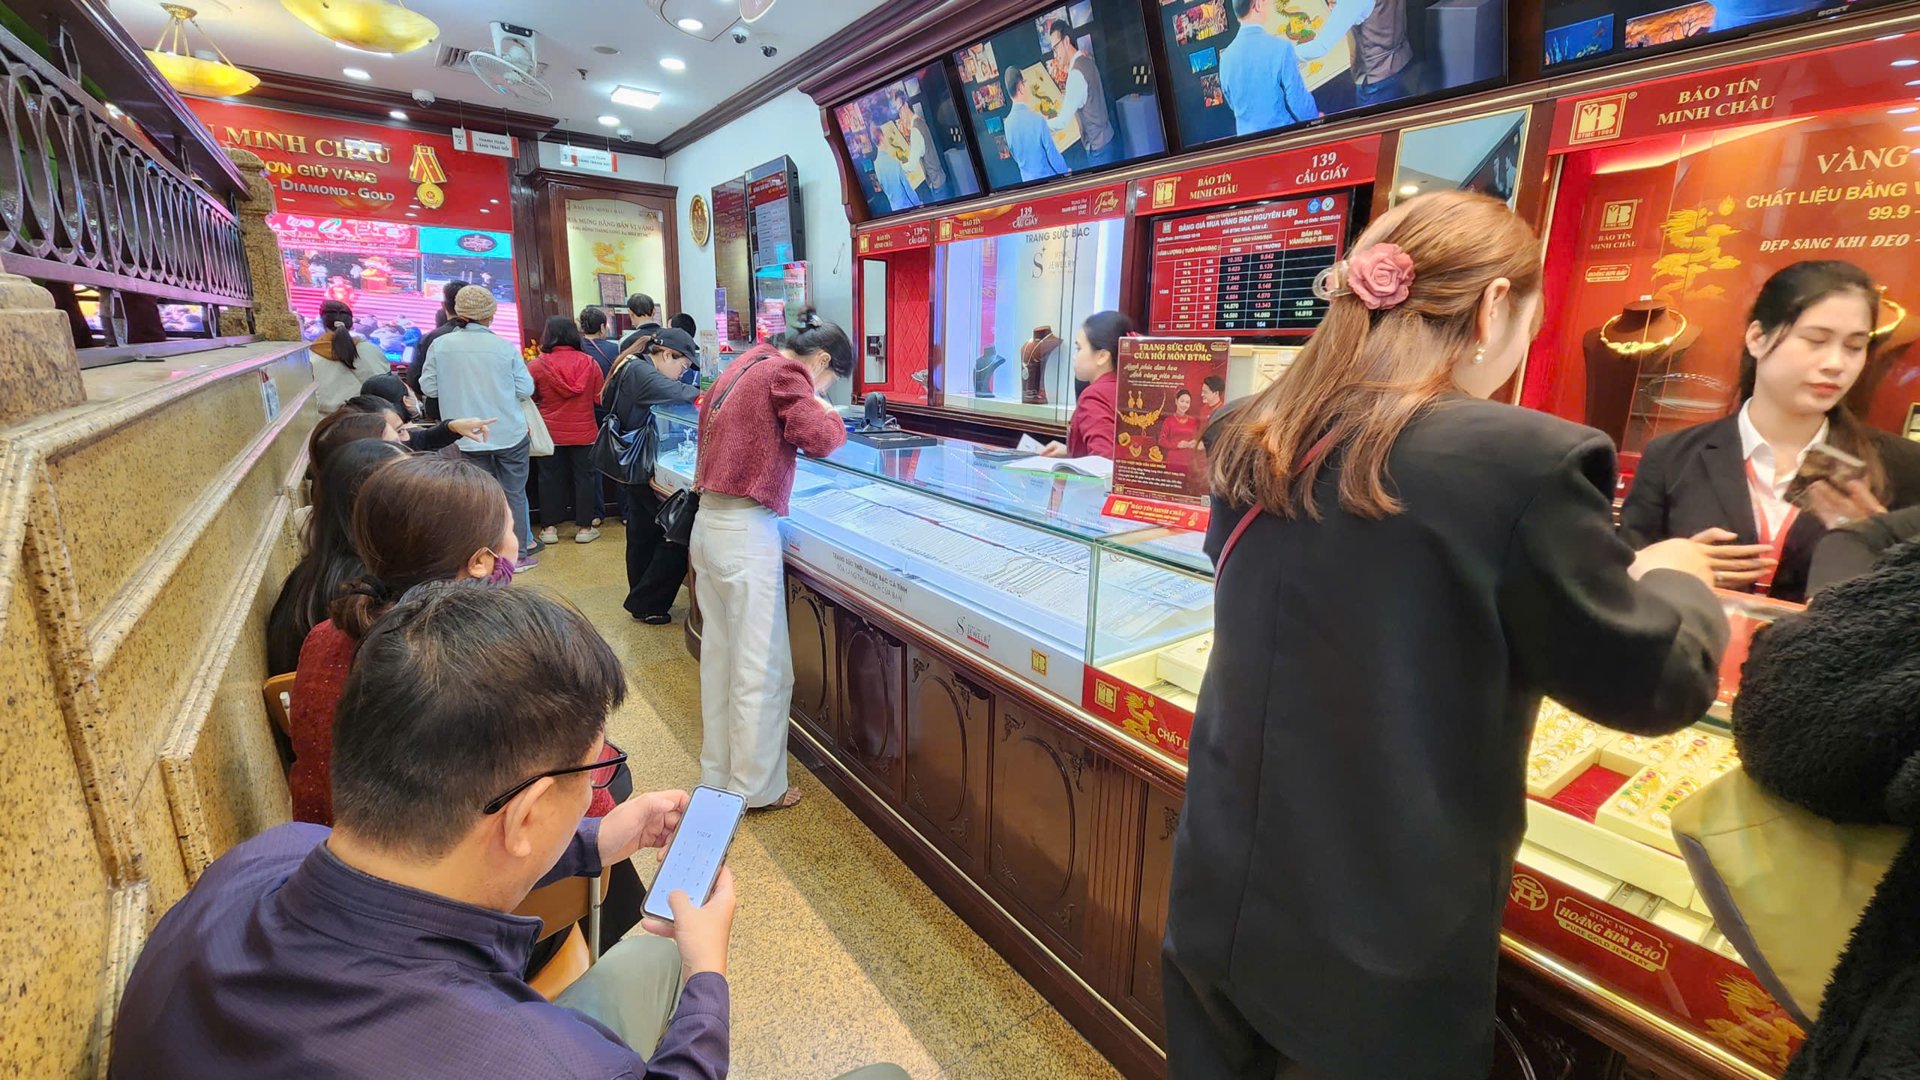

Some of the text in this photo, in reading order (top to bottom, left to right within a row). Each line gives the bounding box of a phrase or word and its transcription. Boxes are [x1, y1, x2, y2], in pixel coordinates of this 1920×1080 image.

[1817, 5, 1850, 18] SONY
[1677, 77, 1761, 105] BẢO TÍN
[1656, 95, 1777, 126] MINH CHÂU
[225, 126, 309, 155] MINH
[315, 137, 392, 164] CHÂU
[1311, 152, 1338, 168] 139
[1816, 145, 1911, 175] VÀNG
[265, 160, 378, 184] ƠN GIỮ VÀNG
[1197, 171, 1233, 188] BẢO TÍN
[1295, 163, 1350, 186] CẦU GIẤY
[357, 187, 395, 202] GOLD
[1189, 181, 1239, 200] MINH CHÂU
[1745, 187, 1796, 209] CHẤT
[1798, 186, 1841, 205] LIỆU
[1844, 180, 1907, 201] BẰNG
[1020, 206, 1033, 217] 139
[1206, 220, 1221, 229] MUA
[1221, 217, 1238, 227] VÀNG
[1238, 214, 1253, 226] BẠC
[1253, 210, 1281, 222] NGUYÊN
[1282, 208, 1298, 219] LIỆU
[1867, 204, 1911, 221] 99.9
[914, 226, 923, 236] 139
[1026, 227, 1090, 244] TRANG SỨC BẠC
[1617, 232, 1632, 241] TÍN
[1613, 239, 1637, 249] CHÂU
[1760, 233, 1911, 254] ĐẸP SANG KHI ĐEO
[1133, 350, 1213, 362] CỦA HỒI MÔN BTMC
[1138, 342, 1166, 352] TRANG
[1166, 341, 1184, 352] SỨC
[1184, 342, 1208, 354] CƯỚI,
[1156, 726, 1183, 748] CHẤT
[1589, 911, 1614, 926] BTMC
[1559, 907, 1662, 964] HOÀNG KIM BẢO
[1565, 922, 1649, 967] PURE GOLD JEWELRY
